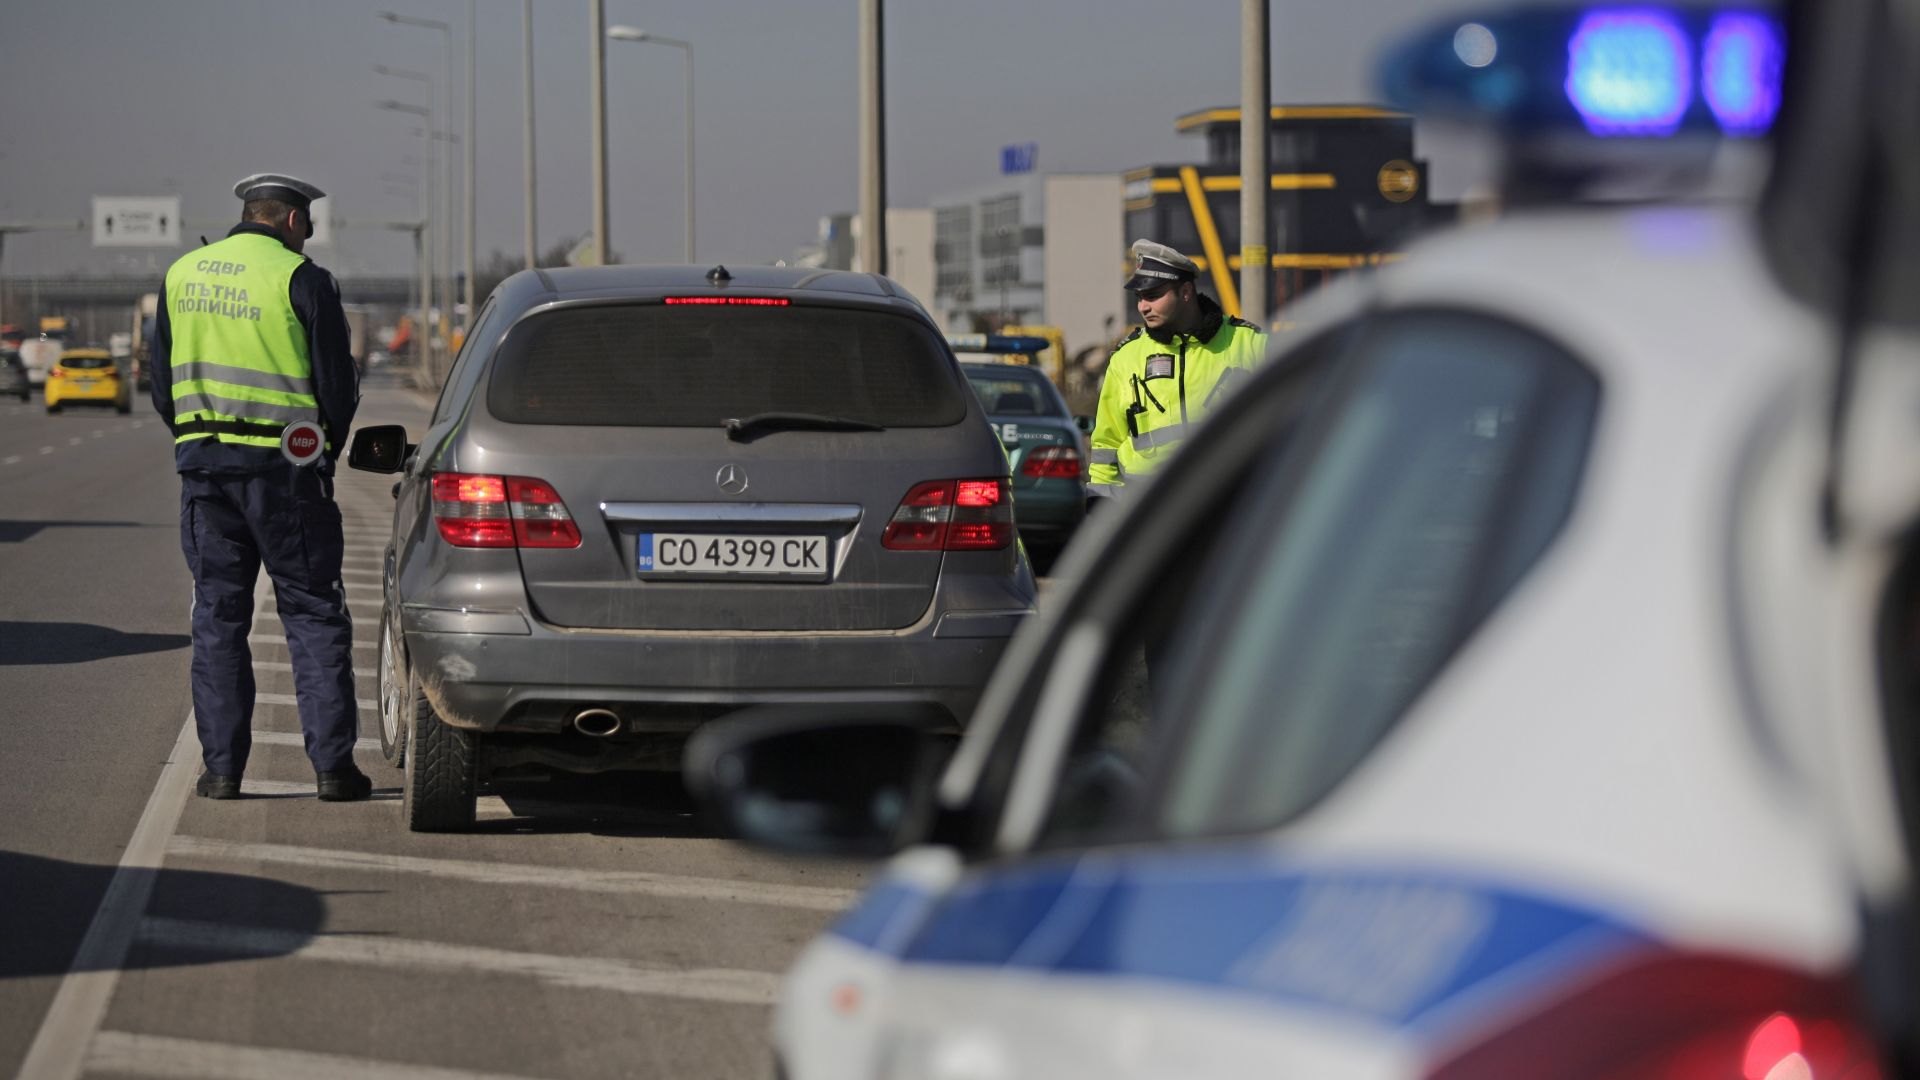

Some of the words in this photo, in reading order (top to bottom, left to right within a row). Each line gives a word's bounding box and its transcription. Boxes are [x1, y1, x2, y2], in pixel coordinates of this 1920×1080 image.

[196, 259, 246, 276] СДВР
[185, 282, 249, 303] ПЪТНА
[177, 298, 262, 322] ПОЛИЦИЯ
[291, 436, 316, 448] МВР
[658, 538, 697, 566] CO
[704, 539, 776, 567] 4399
[782, 540, 819, 568] CK
